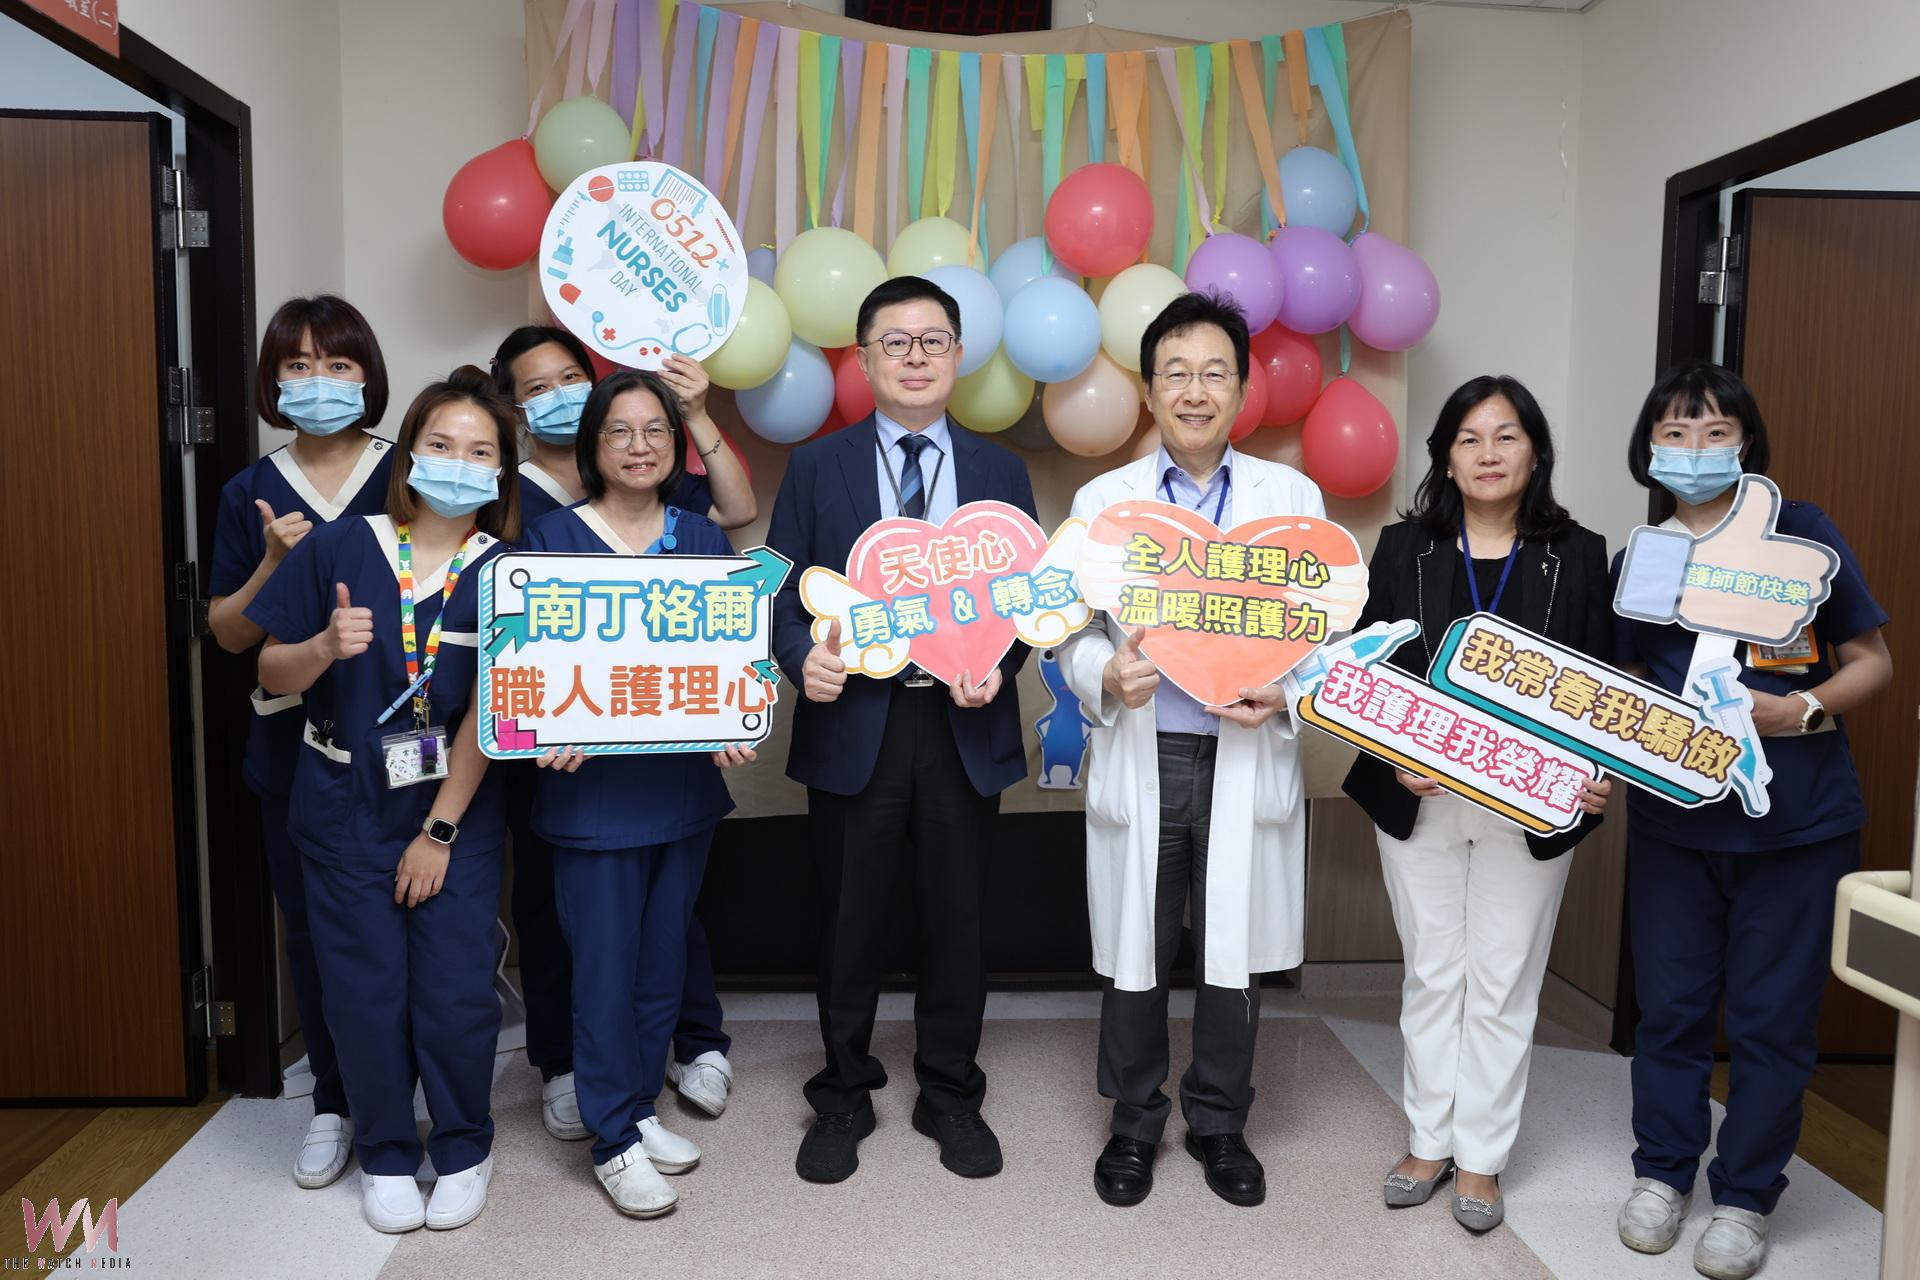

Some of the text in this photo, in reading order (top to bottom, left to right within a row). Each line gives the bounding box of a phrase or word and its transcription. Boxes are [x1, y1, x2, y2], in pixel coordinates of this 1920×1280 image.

[618, 203, 703, 296] INTERNATIONAL
[650, 197, 719, 269] 0512
[596, 219, 687, 313] NURSES
[608, 270, 639, 297] DAY
[881, 530, 1017, 594] 天使心
[1124, 533, 1331, 588] 全人護理心
[1685, 563, 1812, 606] 護師節快樂
[523, 578, 760, 642] 南丁格爾
[850, 566, 1079, 648] 勇氣 & 轉念
[1118, 585, 1328, 643] 溫暖照護力
[490, 664, 774, 720] 職人護理心
[1460, 628, 1741, 783] 我常春我驕傲
[1322, 660, 1590, 814] 我護理我榮耀
